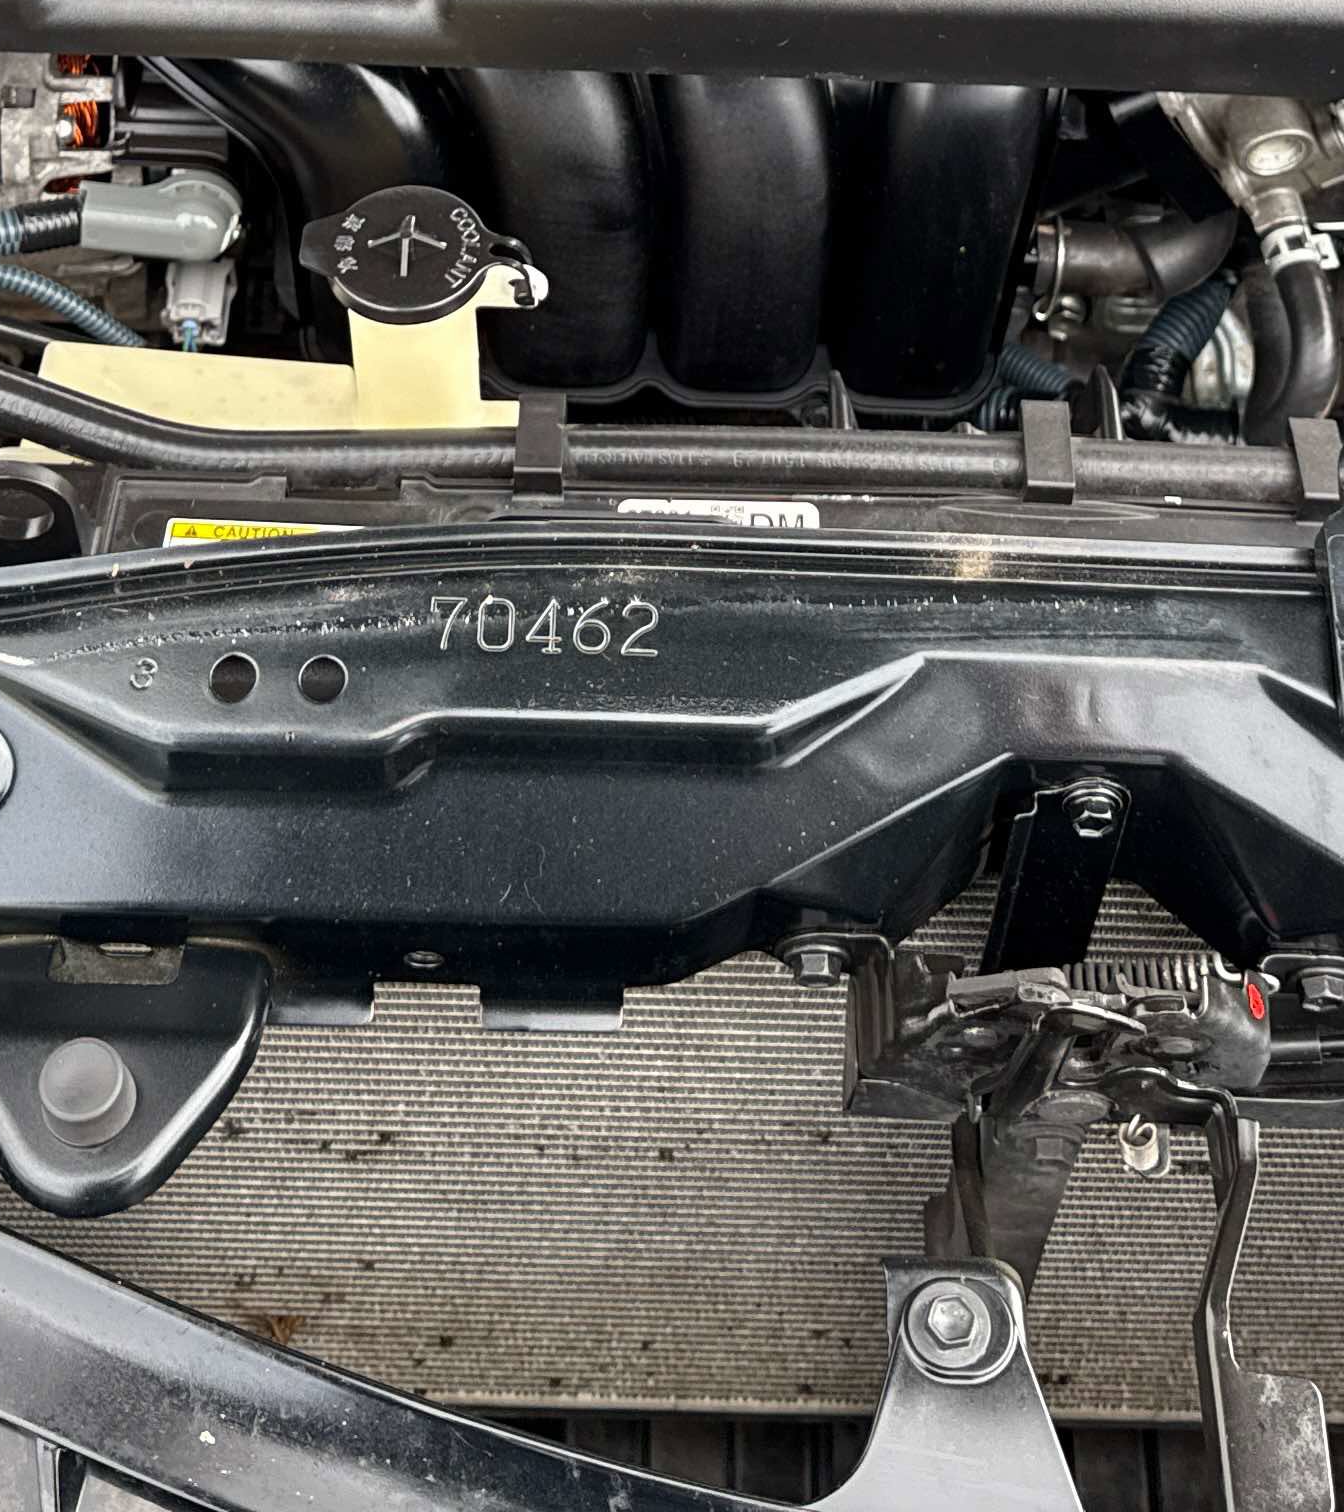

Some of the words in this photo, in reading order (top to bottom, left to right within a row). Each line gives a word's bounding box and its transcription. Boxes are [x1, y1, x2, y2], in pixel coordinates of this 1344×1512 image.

[449, 206, 481, 289] COOLANT
[212, 525, 294, 538] CAUTION
[430, 595, 659, 656] 70462
